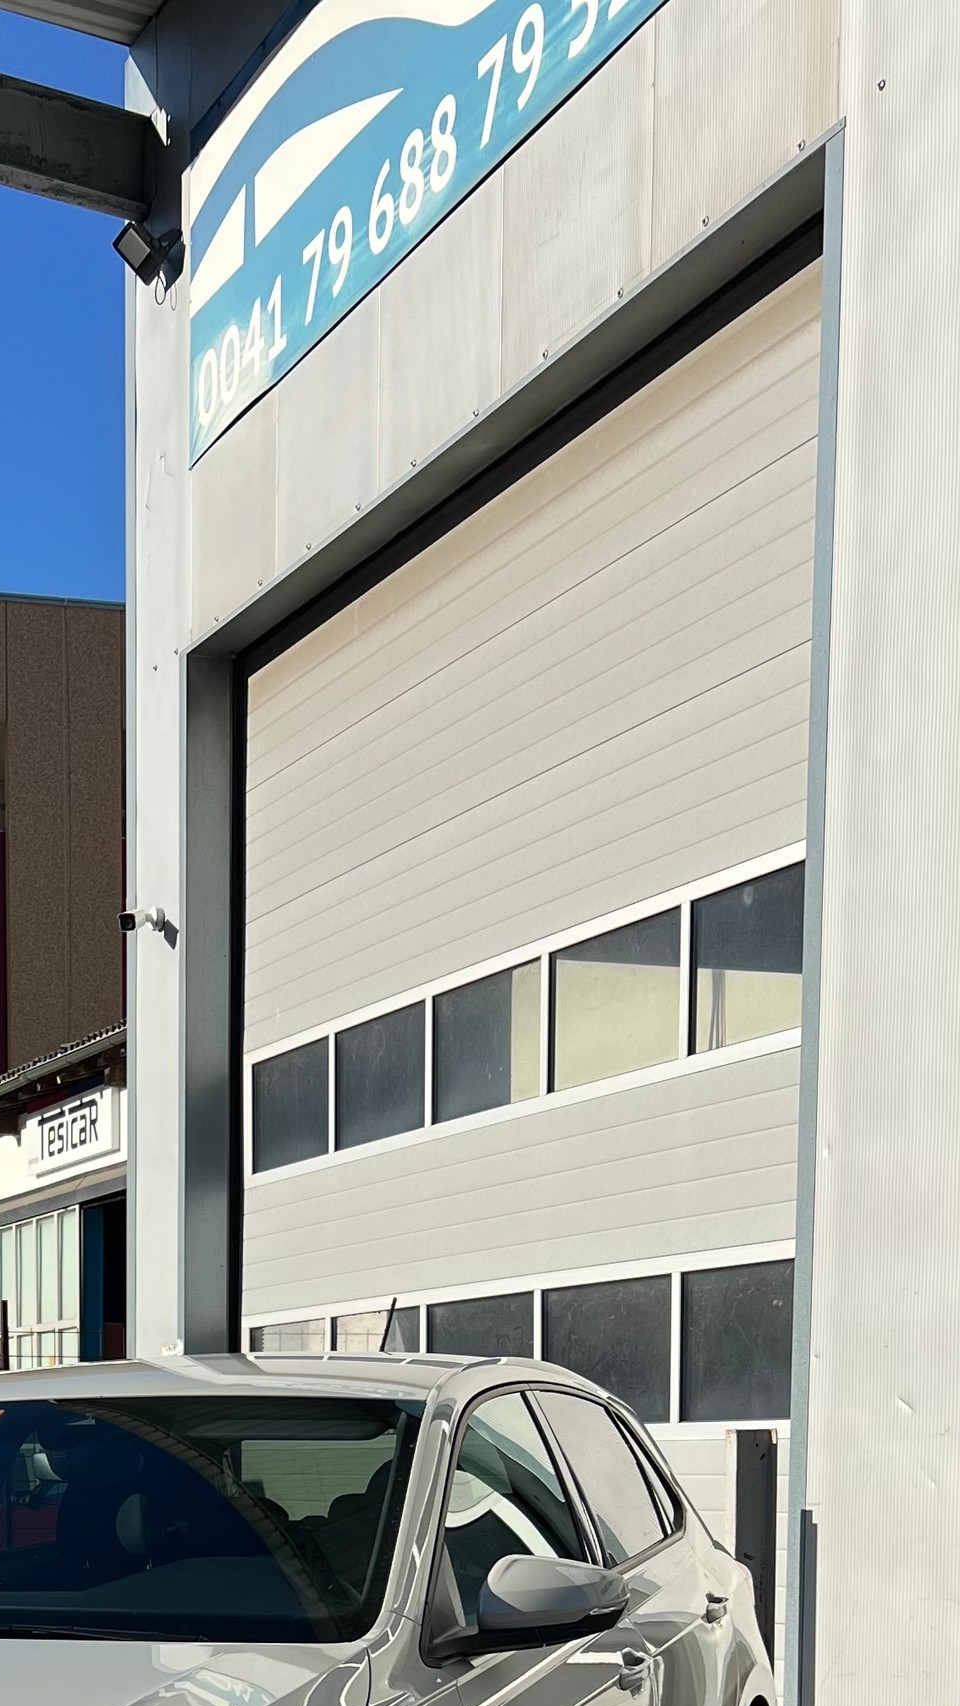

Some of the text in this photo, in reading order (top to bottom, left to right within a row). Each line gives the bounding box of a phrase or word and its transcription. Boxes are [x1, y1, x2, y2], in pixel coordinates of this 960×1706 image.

[197, 274, 287, 427] 0041
[302, 205, 353, 325] 79
[368, 94, 457, 252] 688
[477, 2, 544, 148] 79
